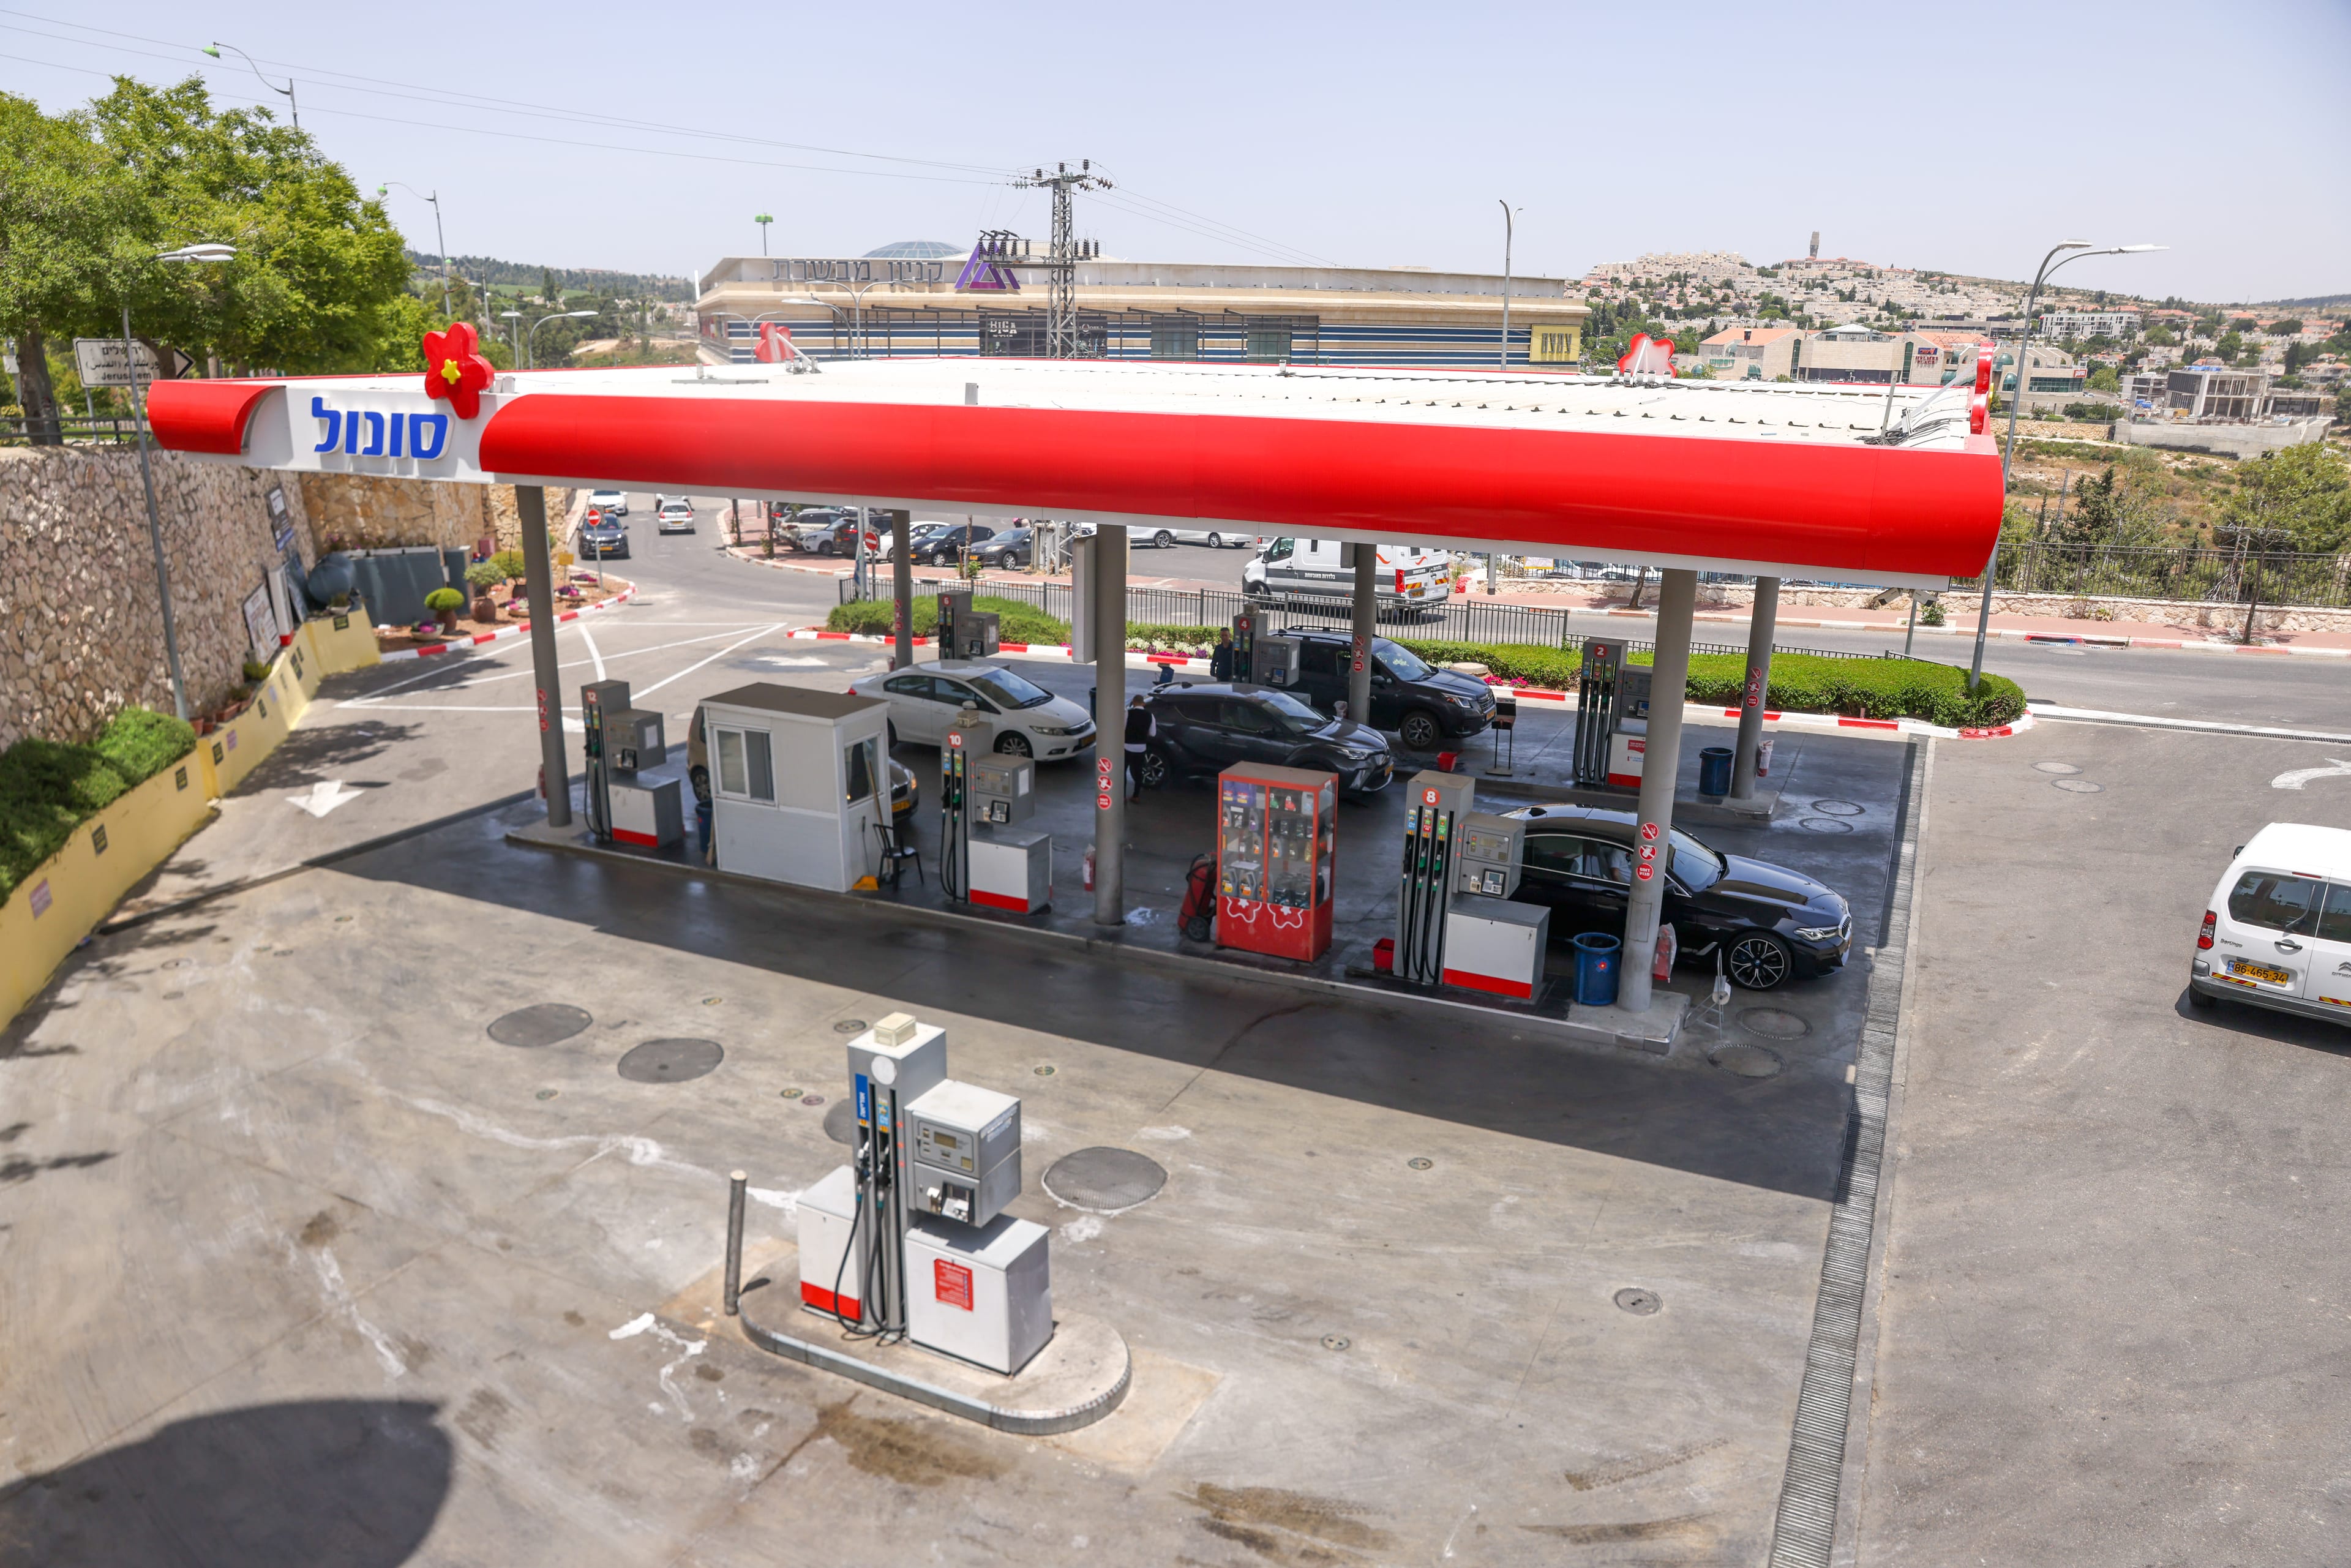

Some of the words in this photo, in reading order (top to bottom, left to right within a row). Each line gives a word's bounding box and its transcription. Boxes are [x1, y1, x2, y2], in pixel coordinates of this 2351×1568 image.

[773, 260, 871, 281] מבשרת
[887, 261, 944, 287] קניון
[312, 396, 449, 460] סונול
[1241, 620, 1248, 629] 4
[1597, 647, 1605, 656] 2
[587, 691, 598, 702] 12
[949, 734, 961, 746] 10
[1426, 790, 1436, 803] 8
[2220, 938, 2243, 948] Berlingo
